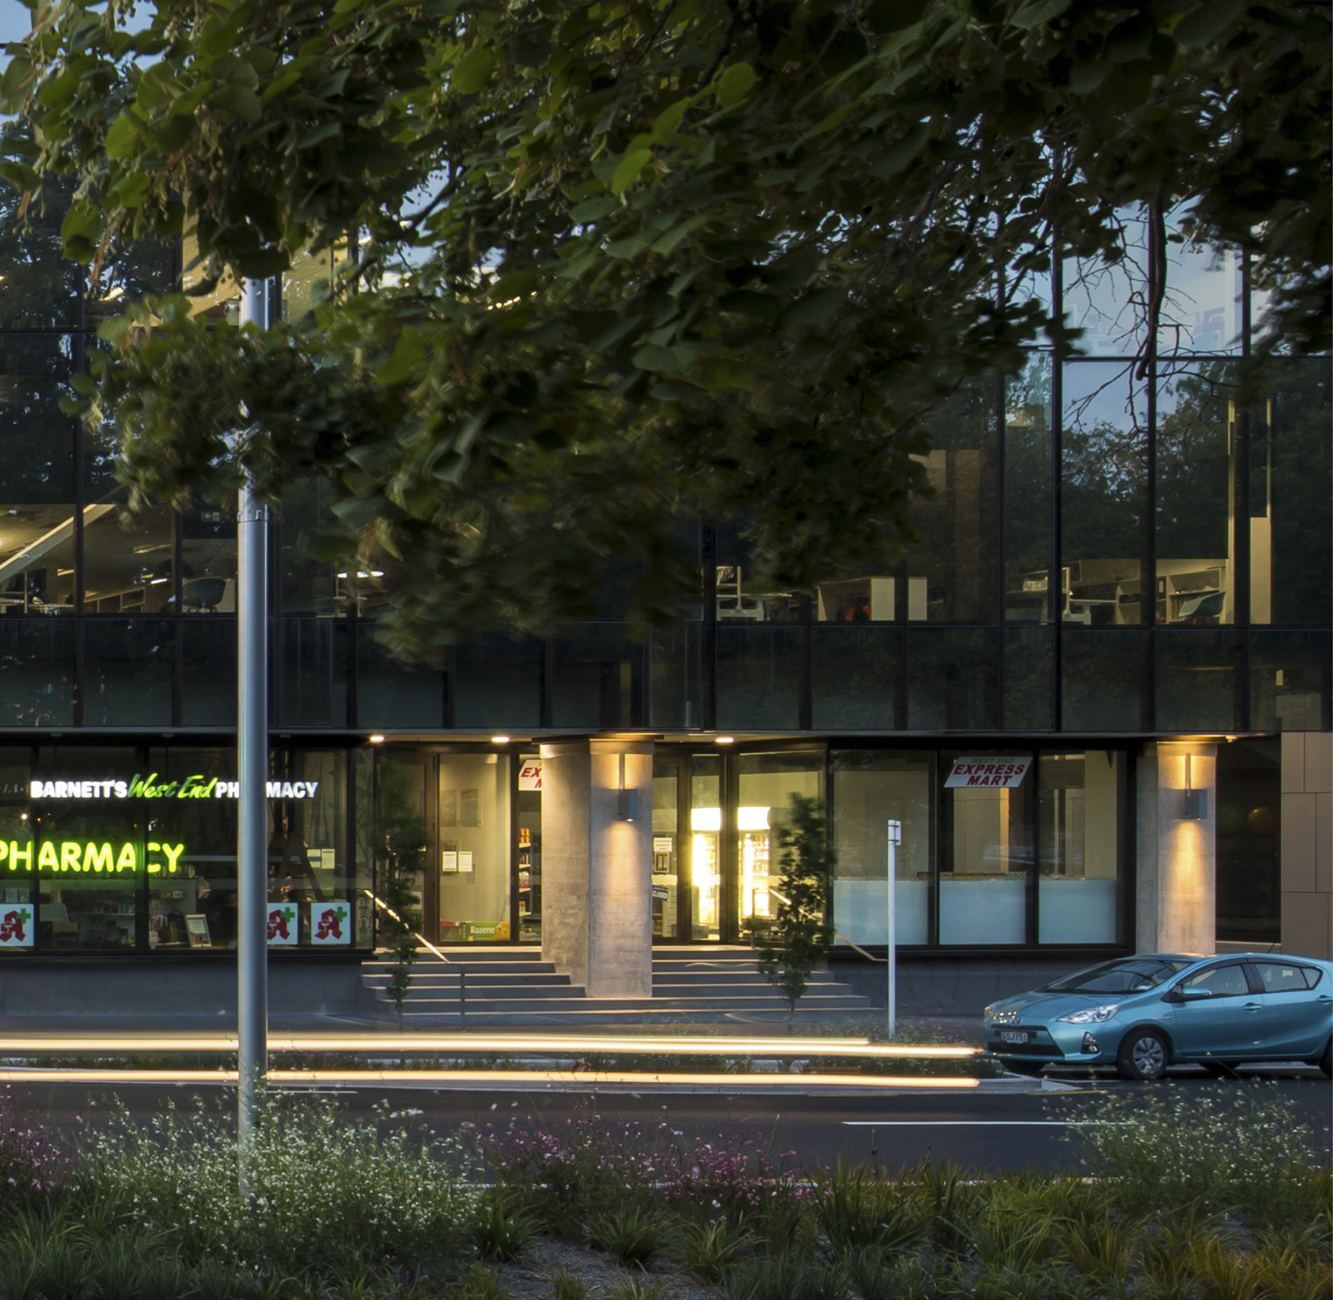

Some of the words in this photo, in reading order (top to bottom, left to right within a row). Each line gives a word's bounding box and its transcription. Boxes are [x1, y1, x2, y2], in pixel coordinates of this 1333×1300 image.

[953, 764, 1025, 775] EXPRESS
[30, 779, 128, 798] BARNETT'S
[127, 773, 179, 798] West
[177, 774, 219, 798] End
[215, 781, 319, 799] PHMACY
[966, 775, 1012, 786] MART
[470, 925, 496, 934] Razene
